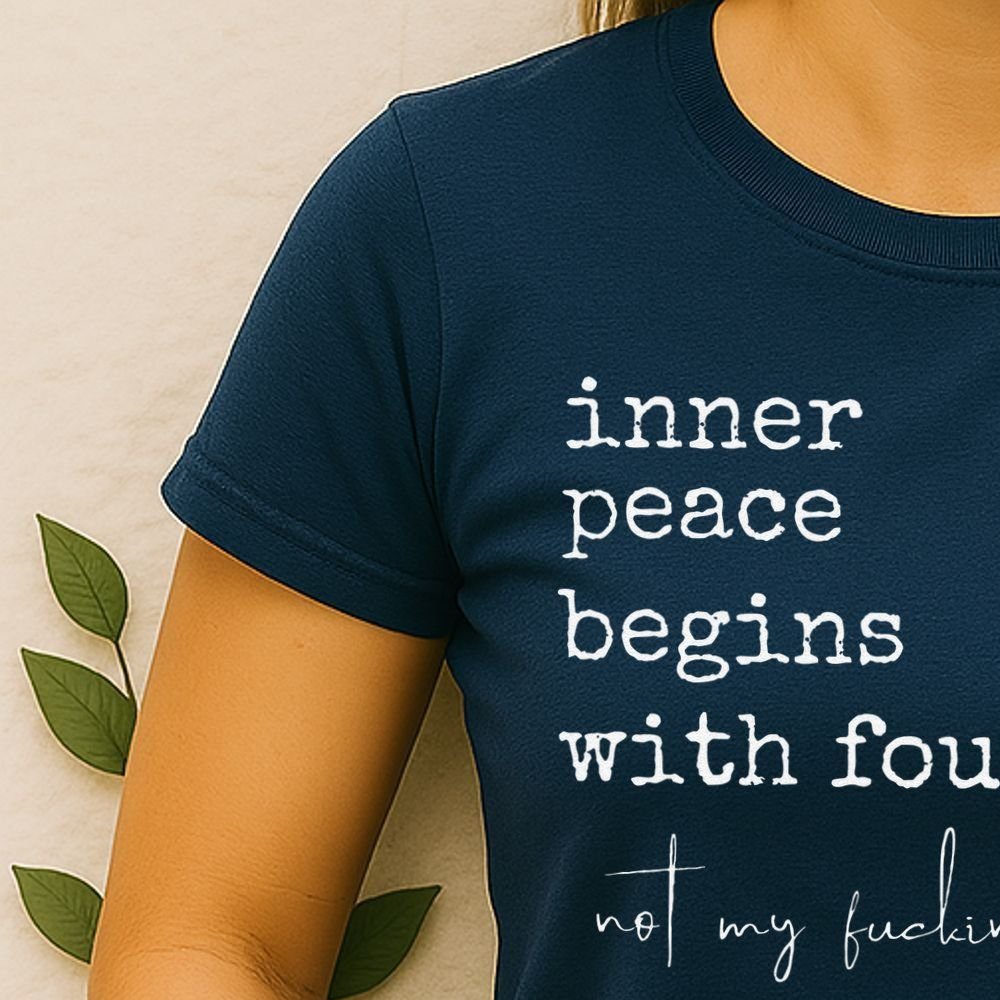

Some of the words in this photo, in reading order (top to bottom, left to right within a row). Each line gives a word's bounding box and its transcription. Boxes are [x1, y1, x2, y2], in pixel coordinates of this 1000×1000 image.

[565, 375, 864, 451] inner
[561, 486, 843, 560] peace
[557, 588, 905, 684] begins
[558, 711, 798, 788] with
[595, 833, 706, 968] not
[718, 914, 807, 983] my
